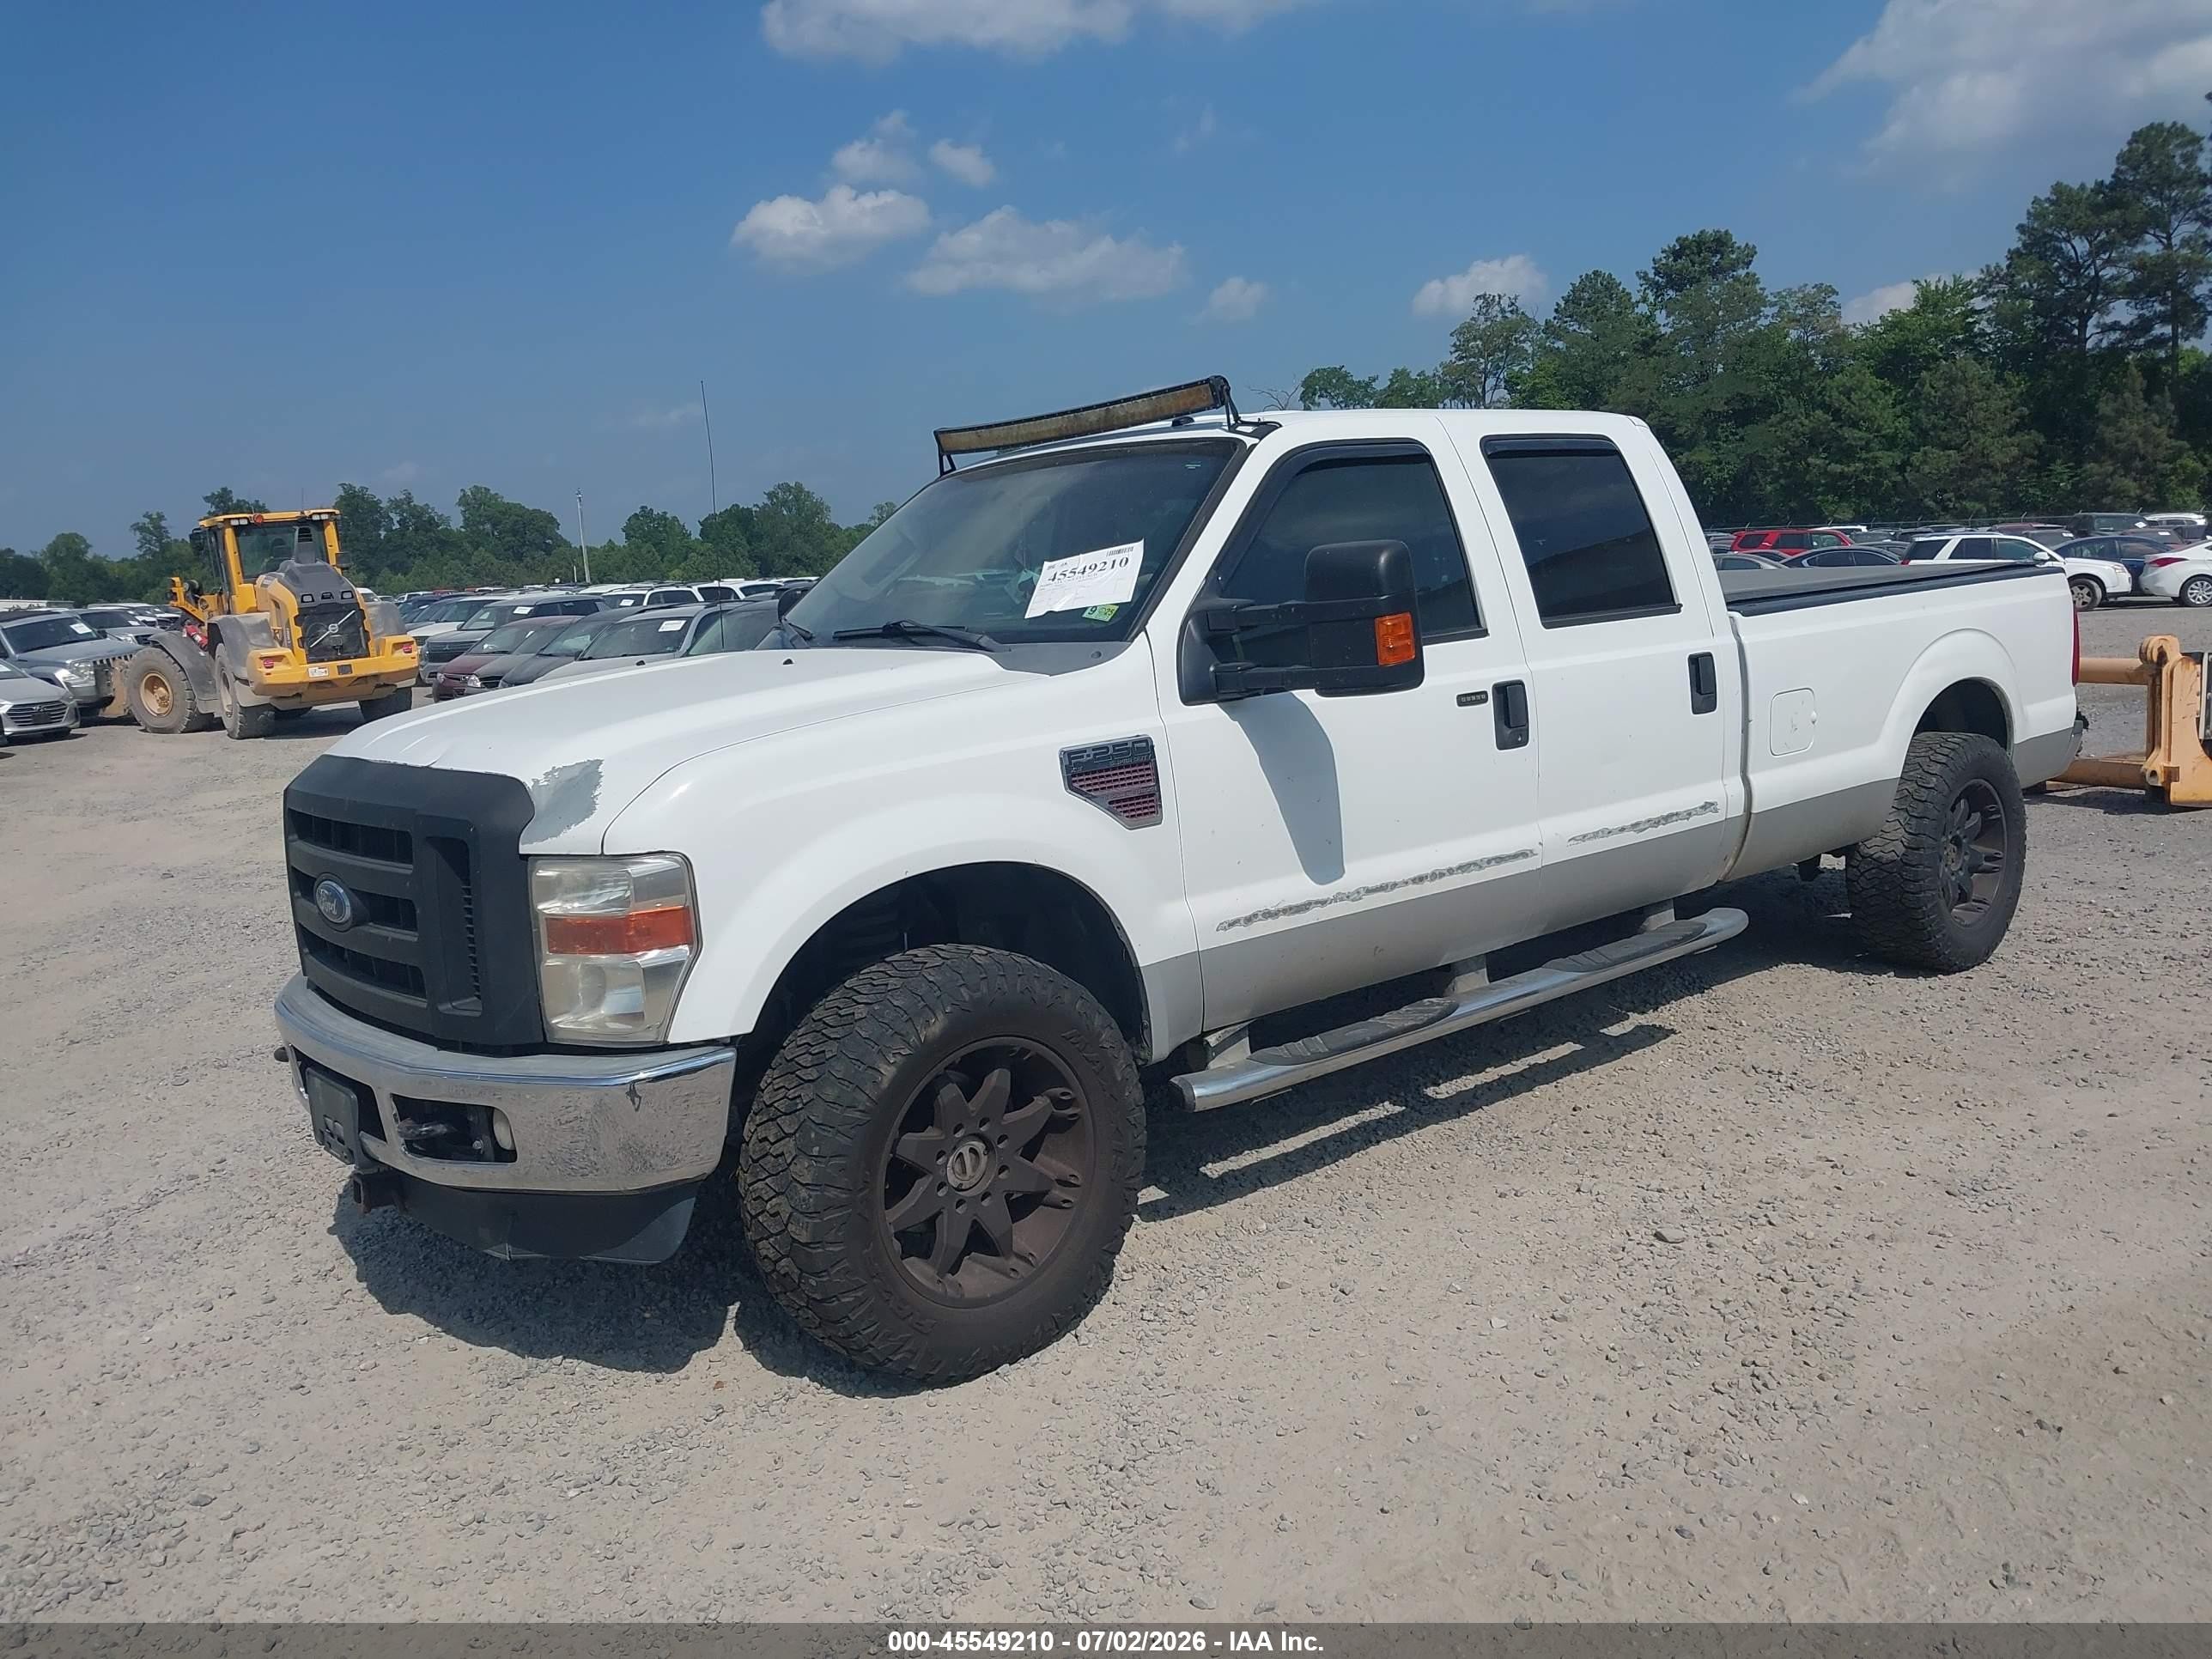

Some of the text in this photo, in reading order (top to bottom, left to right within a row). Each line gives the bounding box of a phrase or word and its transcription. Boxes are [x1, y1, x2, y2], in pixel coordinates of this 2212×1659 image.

[1048, 556, 1129, 583] 45549210
[1088, 605, 1098, 616] 9
[319, 888, 338, 915] Ford
